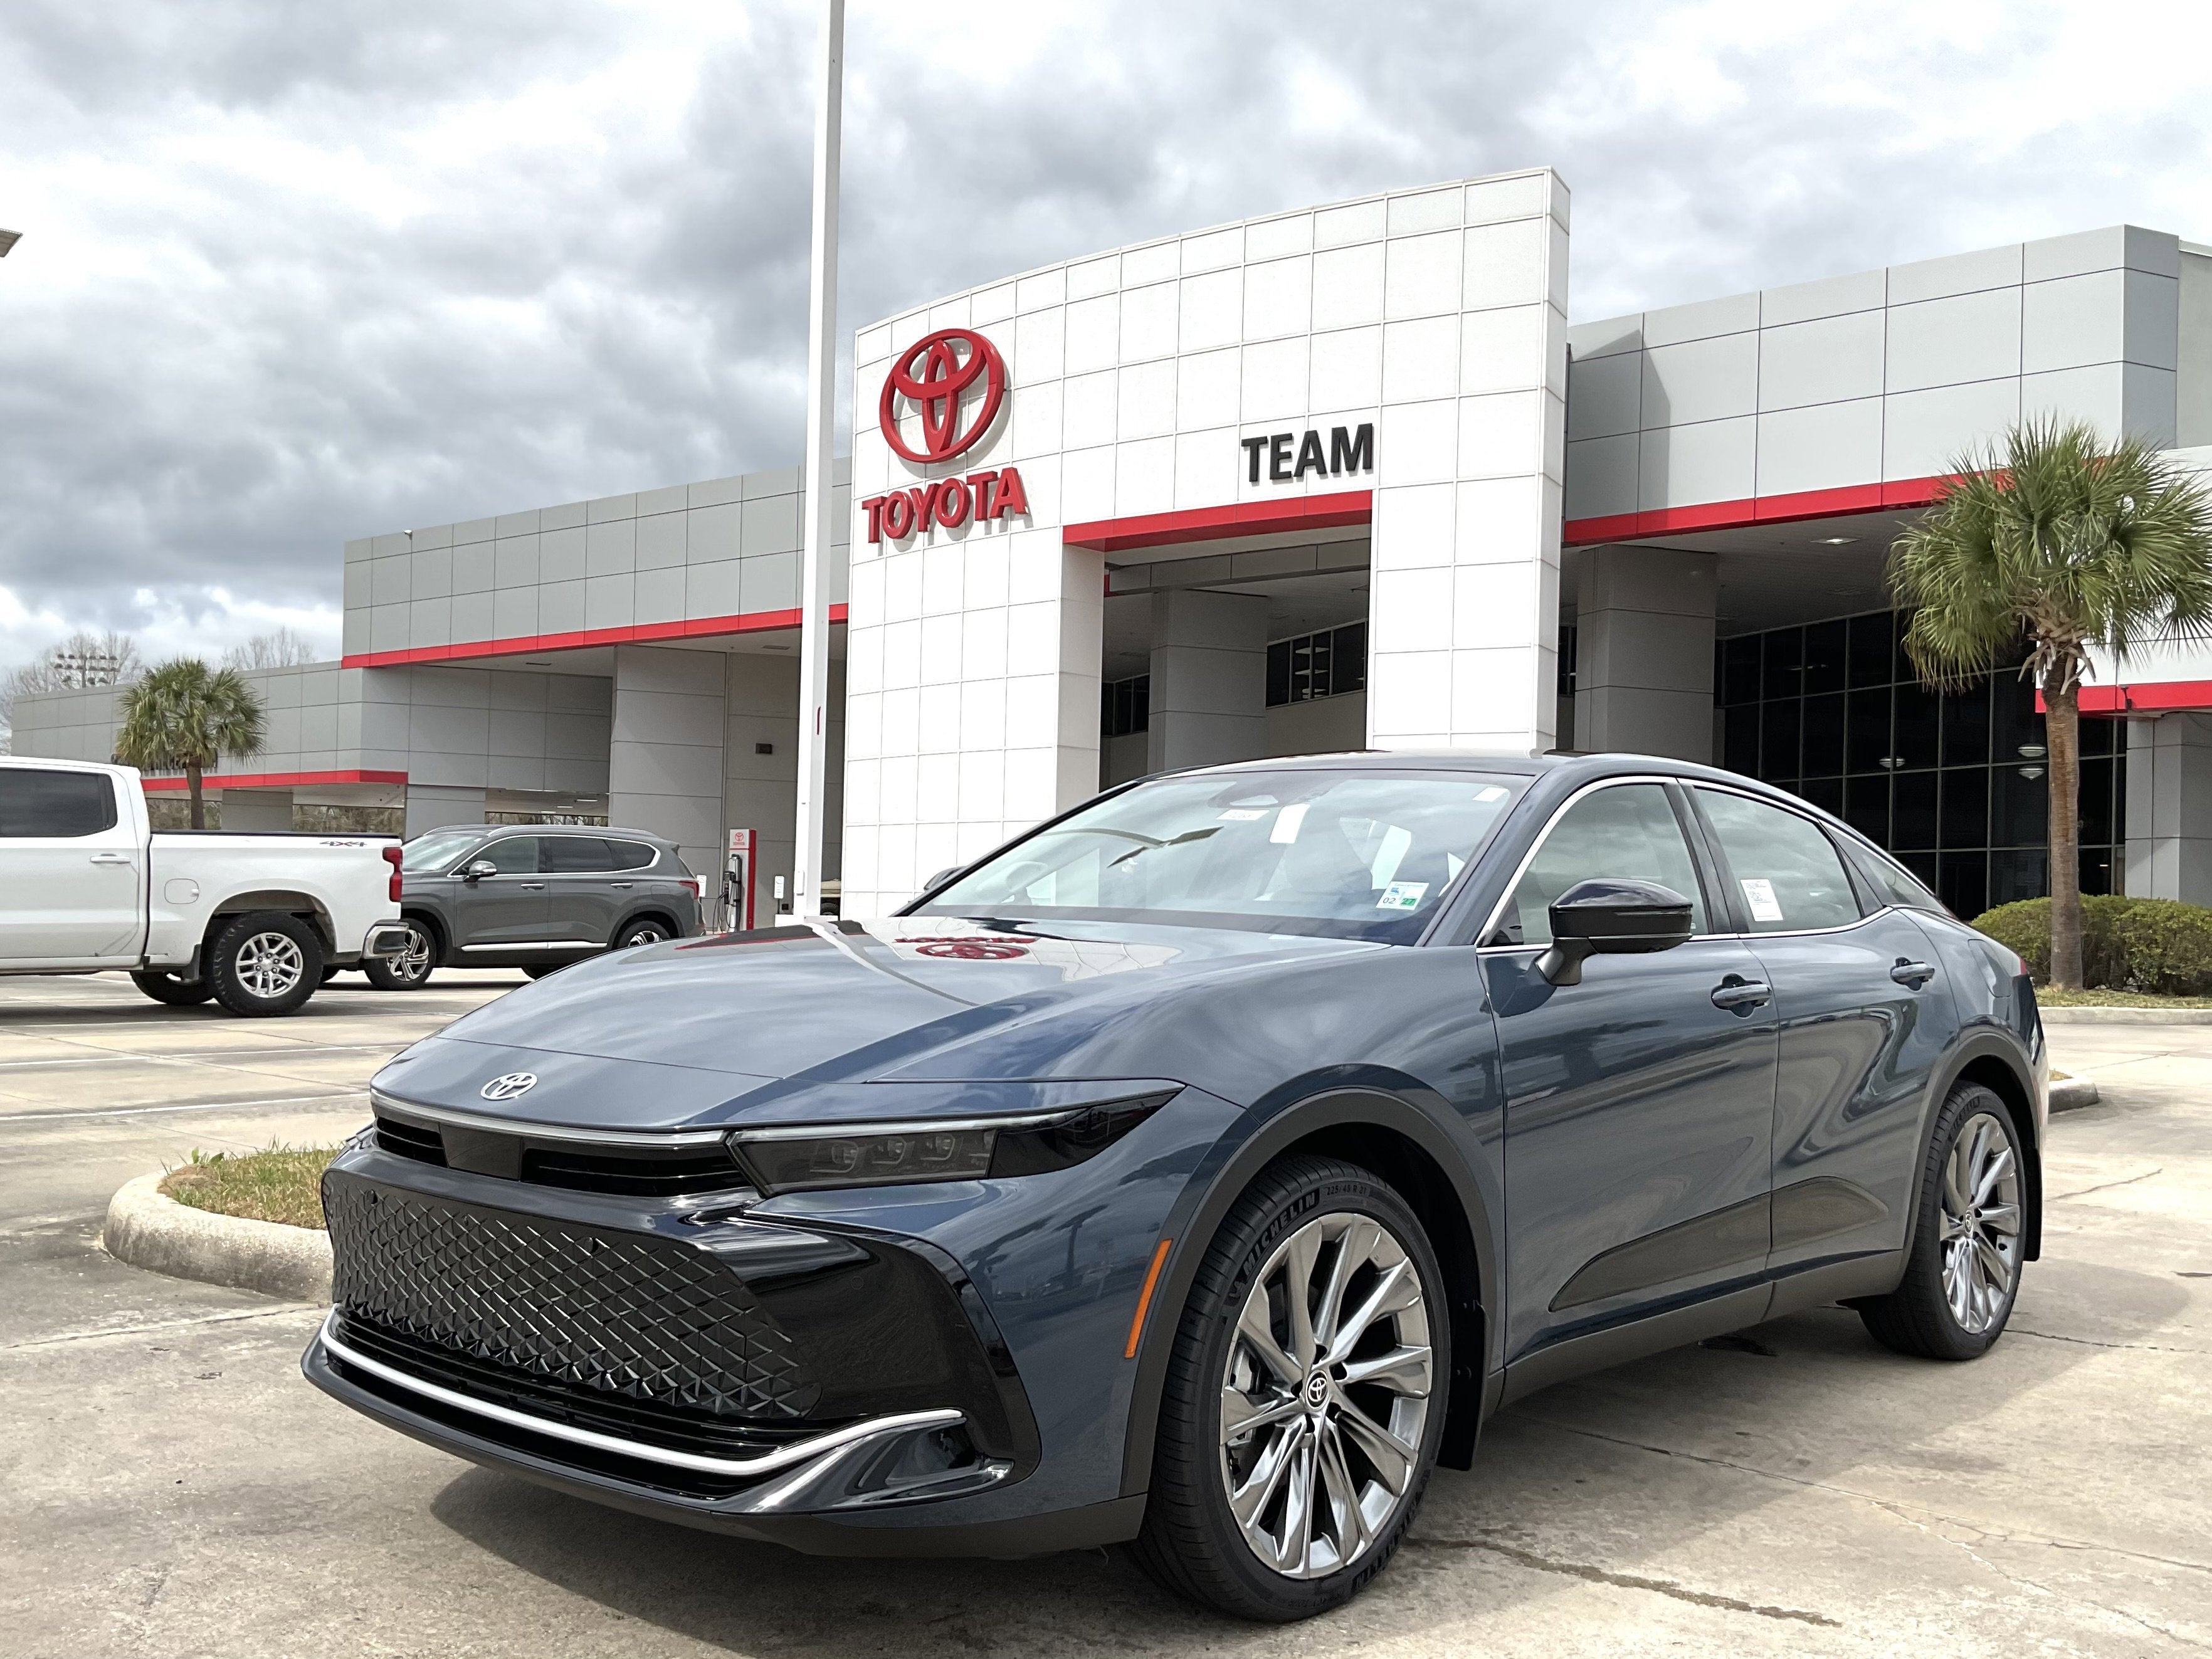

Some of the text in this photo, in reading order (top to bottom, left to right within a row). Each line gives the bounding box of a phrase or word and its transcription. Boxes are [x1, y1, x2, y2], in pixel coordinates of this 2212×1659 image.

[1241, 423, 1372, 482] TEAM
[862, 467, 1028, 544] TOYOTA
[1243, 1191, 1315, 1276] MICHELIN
